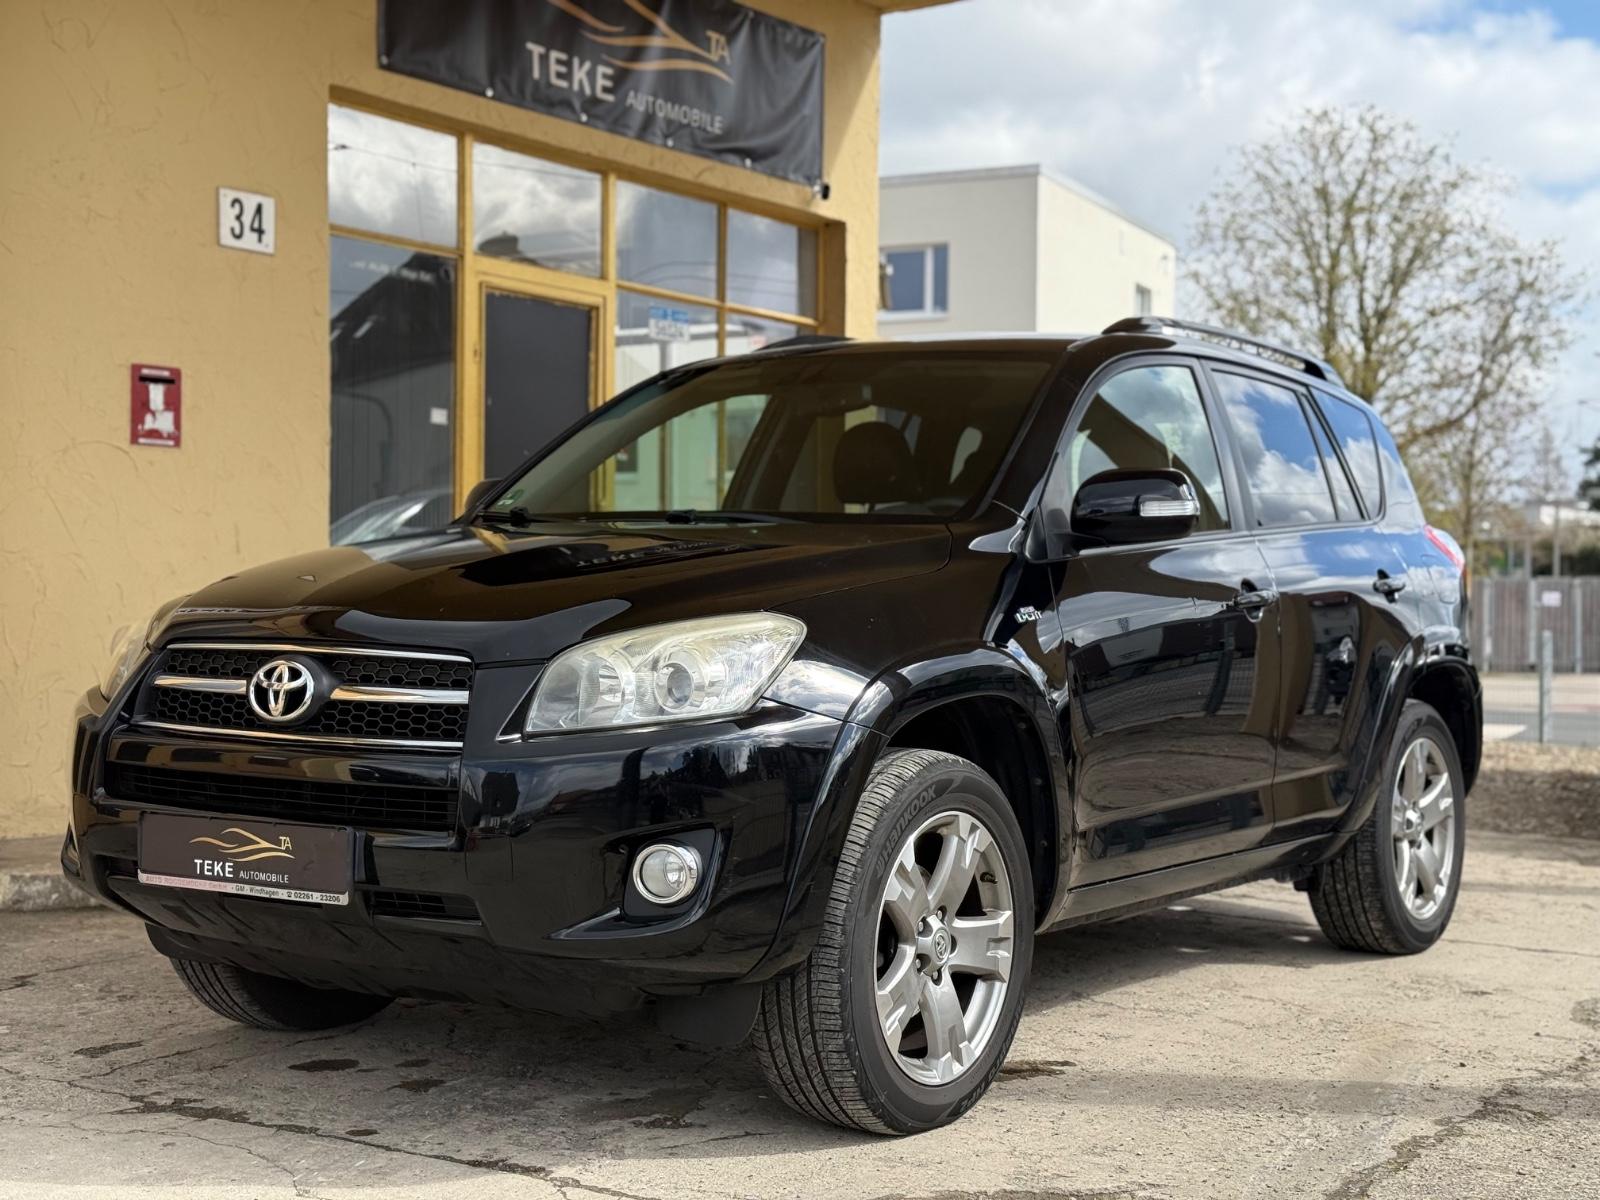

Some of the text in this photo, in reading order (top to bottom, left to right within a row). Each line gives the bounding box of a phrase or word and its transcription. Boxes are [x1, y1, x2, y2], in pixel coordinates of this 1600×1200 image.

[705, 30, 731, 65] TA
[526, 42, 724, 135] TEKE AUTOMOBILE
[230, 197, 265, 244] 34
[279, 836, 292, 850] TA
[194, 859, 289, 884] TEKE AUTOMOBILE
[249, 886, 279, 897] Windhagen
[294, 891, 313, 900] 02261
